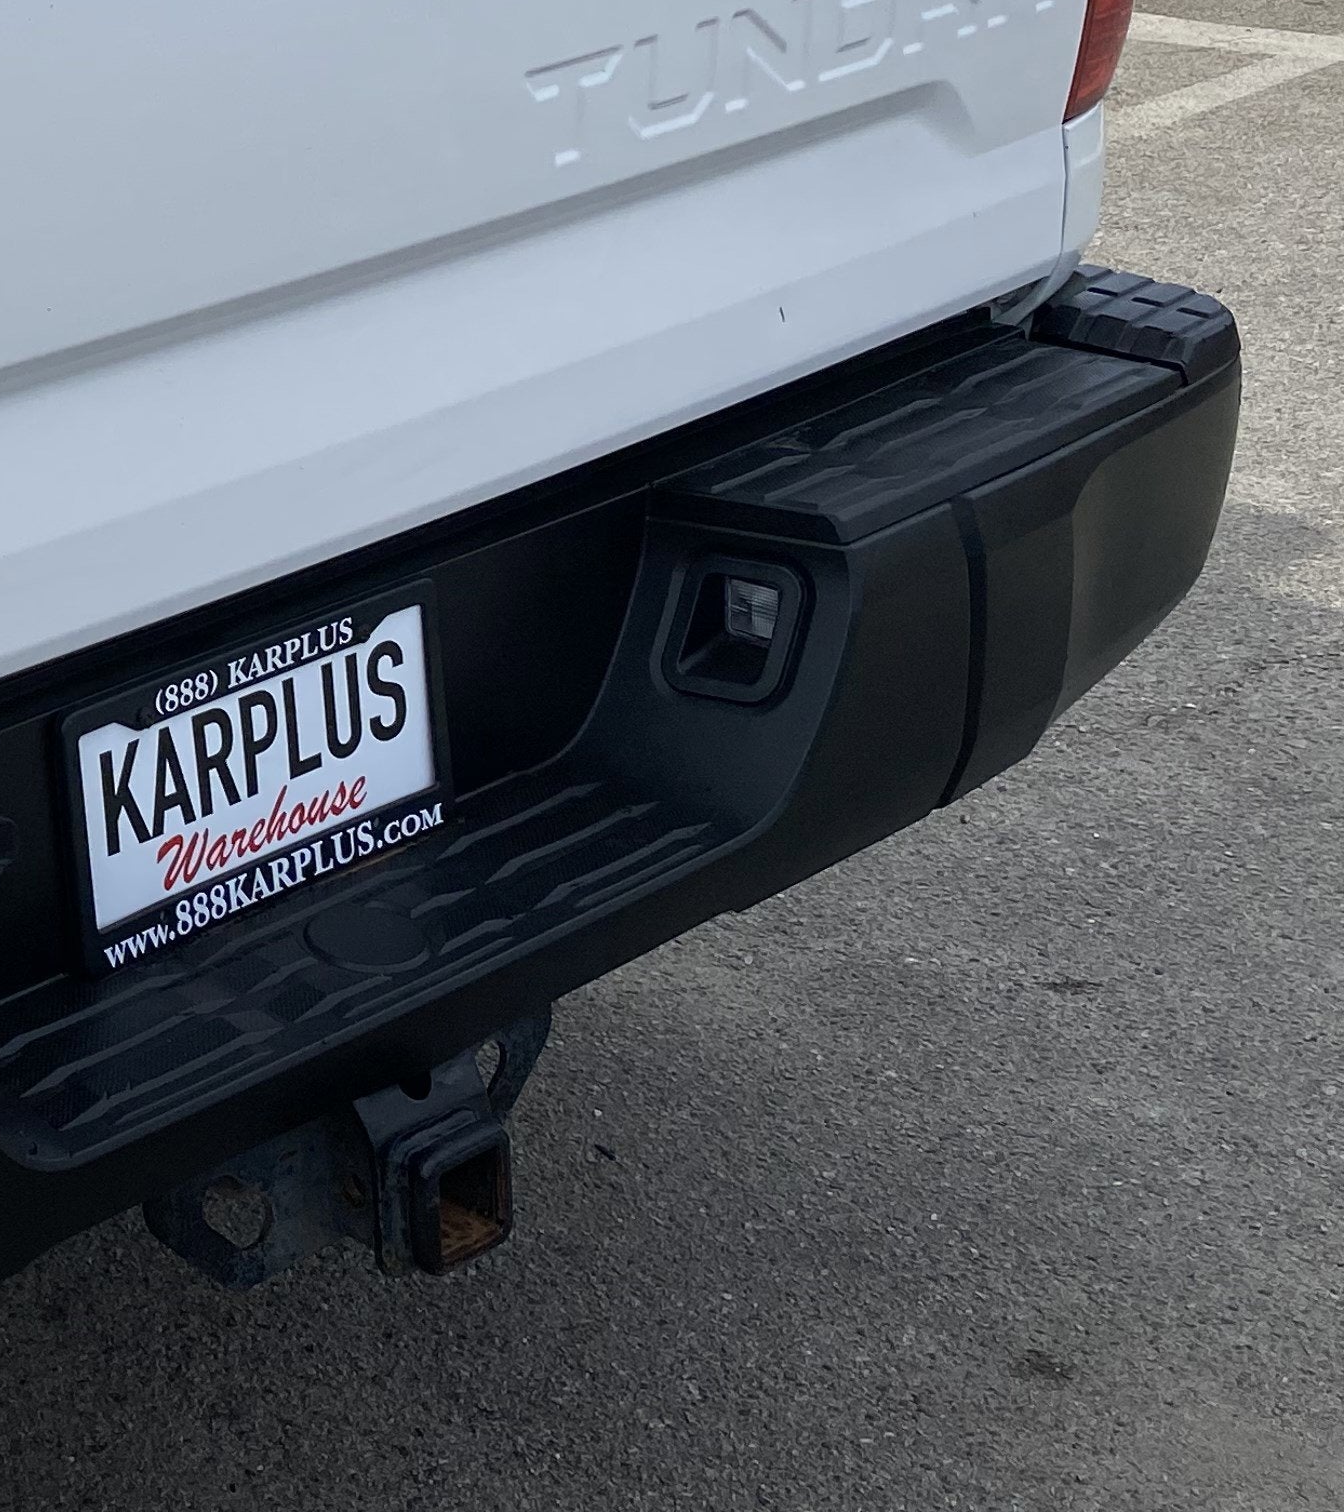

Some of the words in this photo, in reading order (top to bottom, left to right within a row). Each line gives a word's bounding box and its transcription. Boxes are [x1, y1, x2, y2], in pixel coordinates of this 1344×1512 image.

[155, 669, 219, 715] (888)
[227, 617, 354, 690] KARPLUS
[99, 640, 408, 857] KARPLUS
[156, 775, 368, 891] Warehouse
